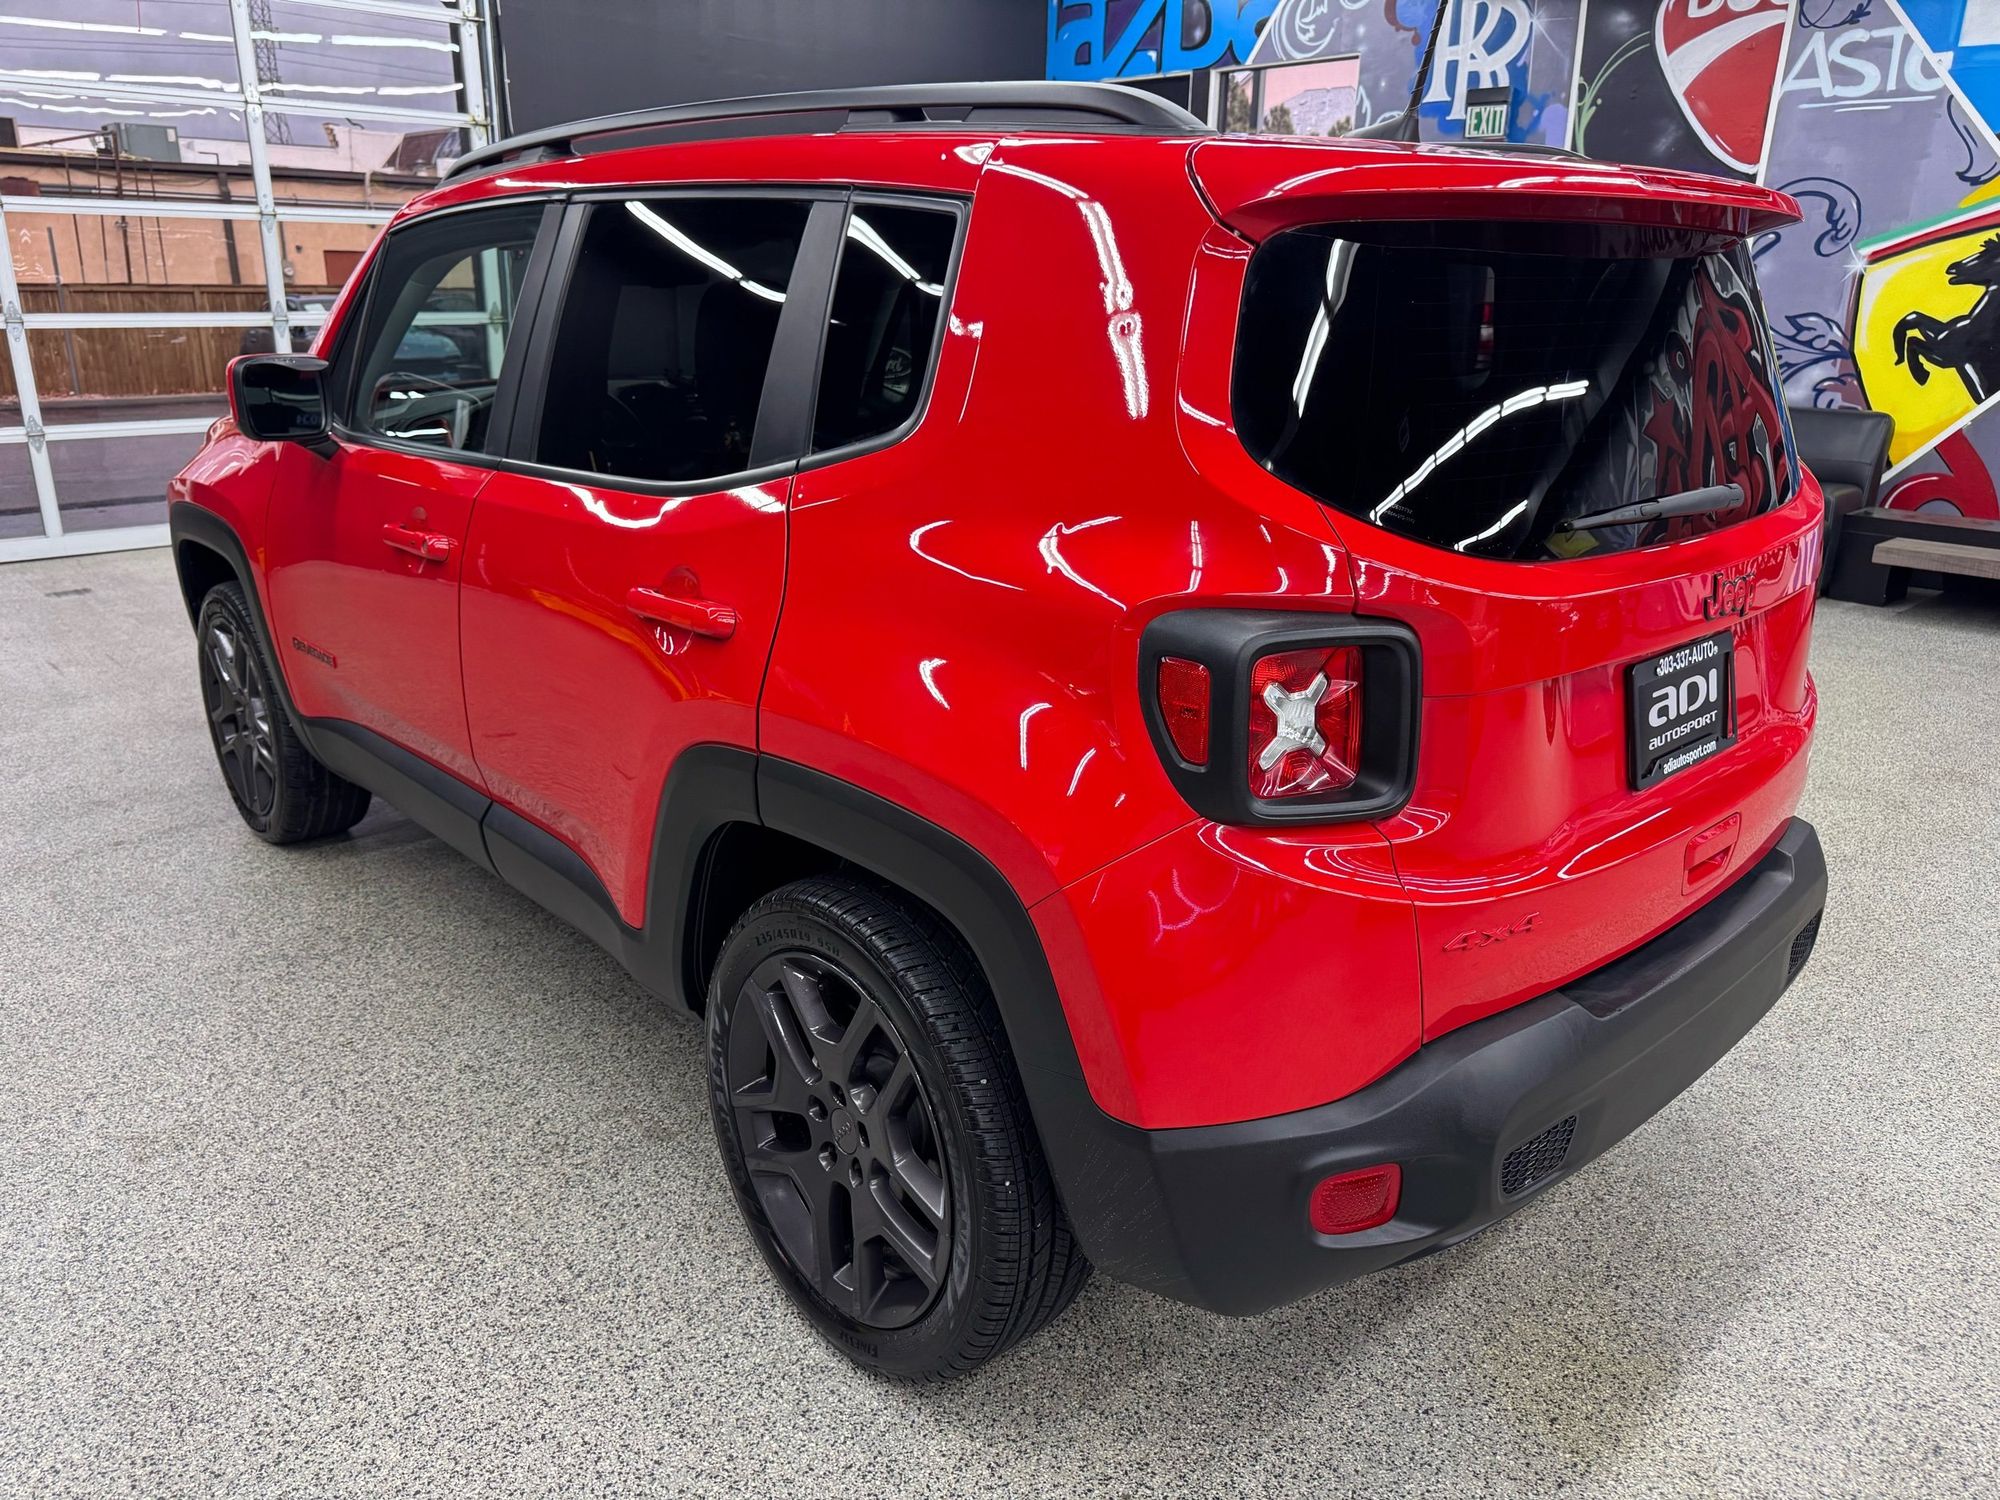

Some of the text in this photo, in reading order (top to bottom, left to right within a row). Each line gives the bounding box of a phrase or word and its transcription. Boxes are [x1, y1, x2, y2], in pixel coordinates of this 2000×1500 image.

[1468, 106, 1504, 136] EXIT
[1703, 572, 1755, 621] Jeep
[1663, 740, 1717, 775] adiautosport.com
